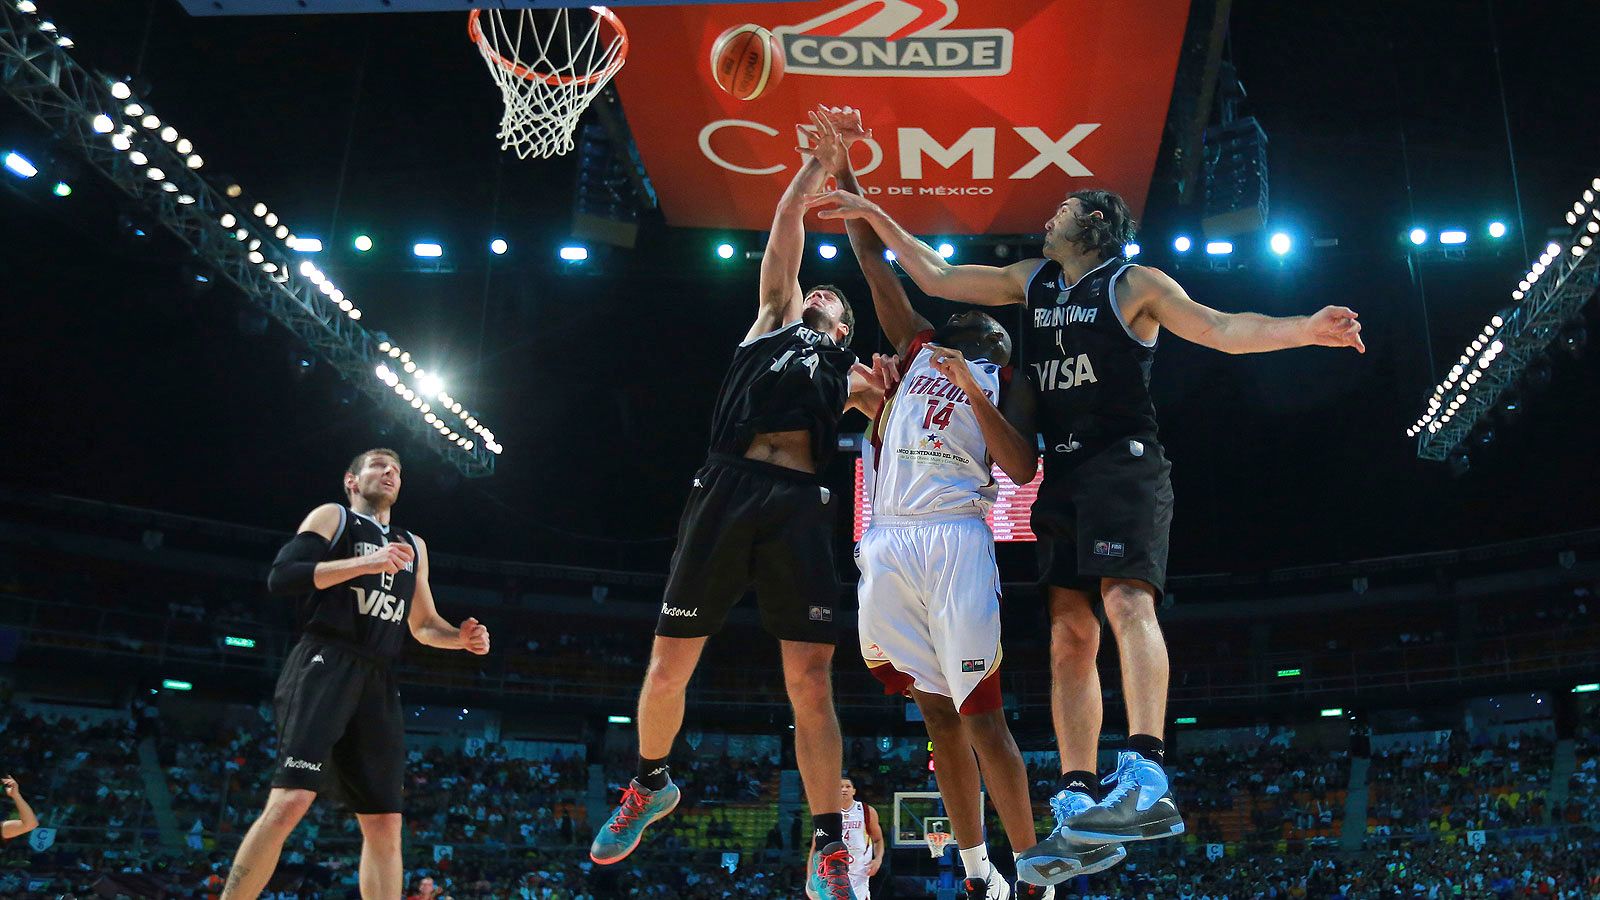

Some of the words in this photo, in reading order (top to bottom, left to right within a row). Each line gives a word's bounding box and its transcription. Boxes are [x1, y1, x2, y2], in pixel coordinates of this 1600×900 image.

[790, 39, 996, 67] CONADE
[888, 186, 913, 196] DE
[918, 185, 994, 196] MÉXICO
[1030, 353, 1098, 392] VISA
[922, 399, 955, 431] 14
[350, 586, 405, 623] VISA
[661, 603, 698, 617] Personal
[284, 756, 323, 771] Personal
